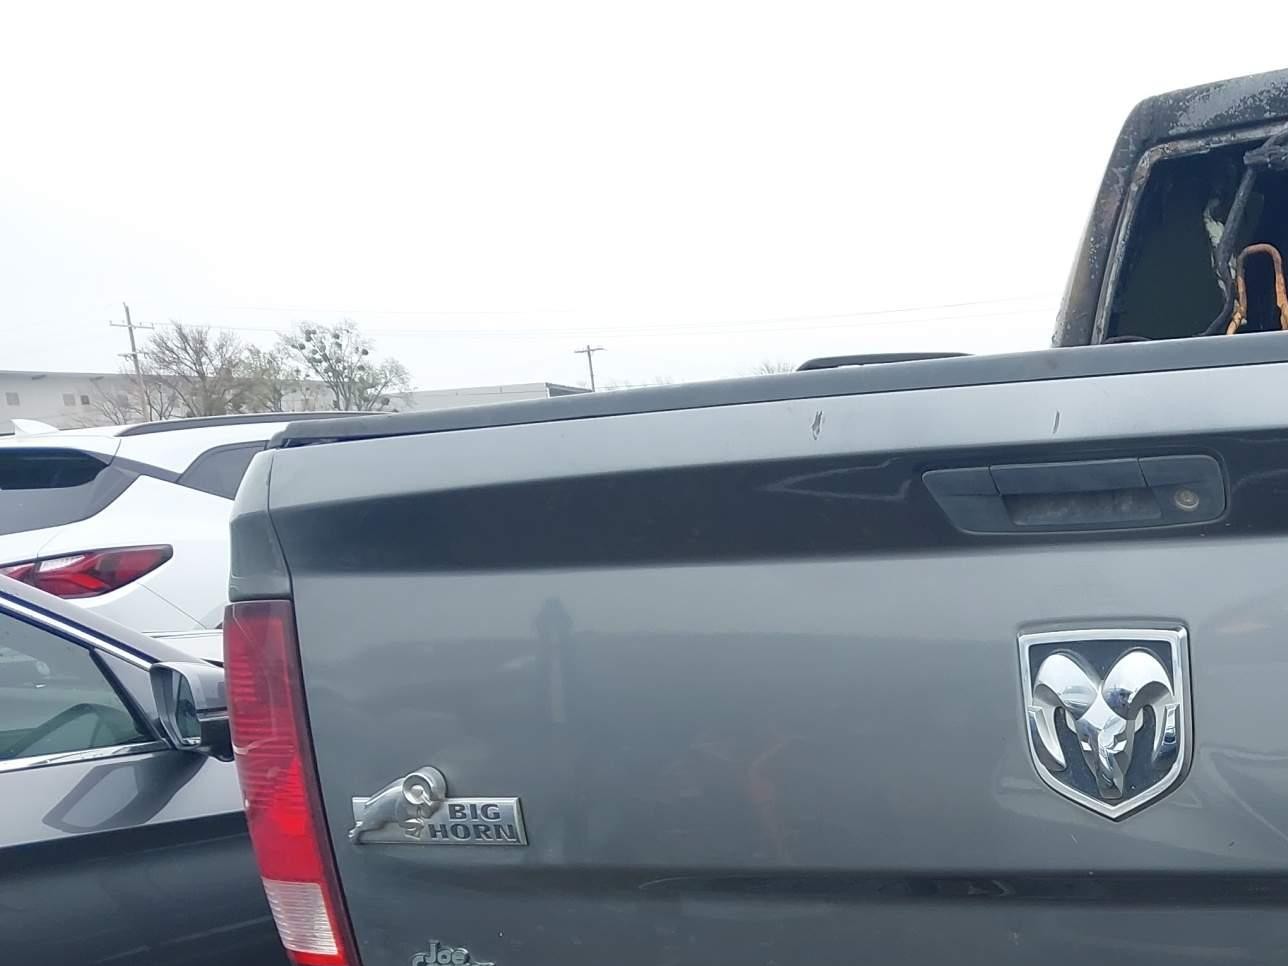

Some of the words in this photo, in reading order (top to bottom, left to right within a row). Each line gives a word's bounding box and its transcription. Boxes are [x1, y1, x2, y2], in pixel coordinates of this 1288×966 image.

[448, 803, 501, 821] BIG
[428, 823, 518, 842] HORN
[425, 940, 468, 965] Joe
